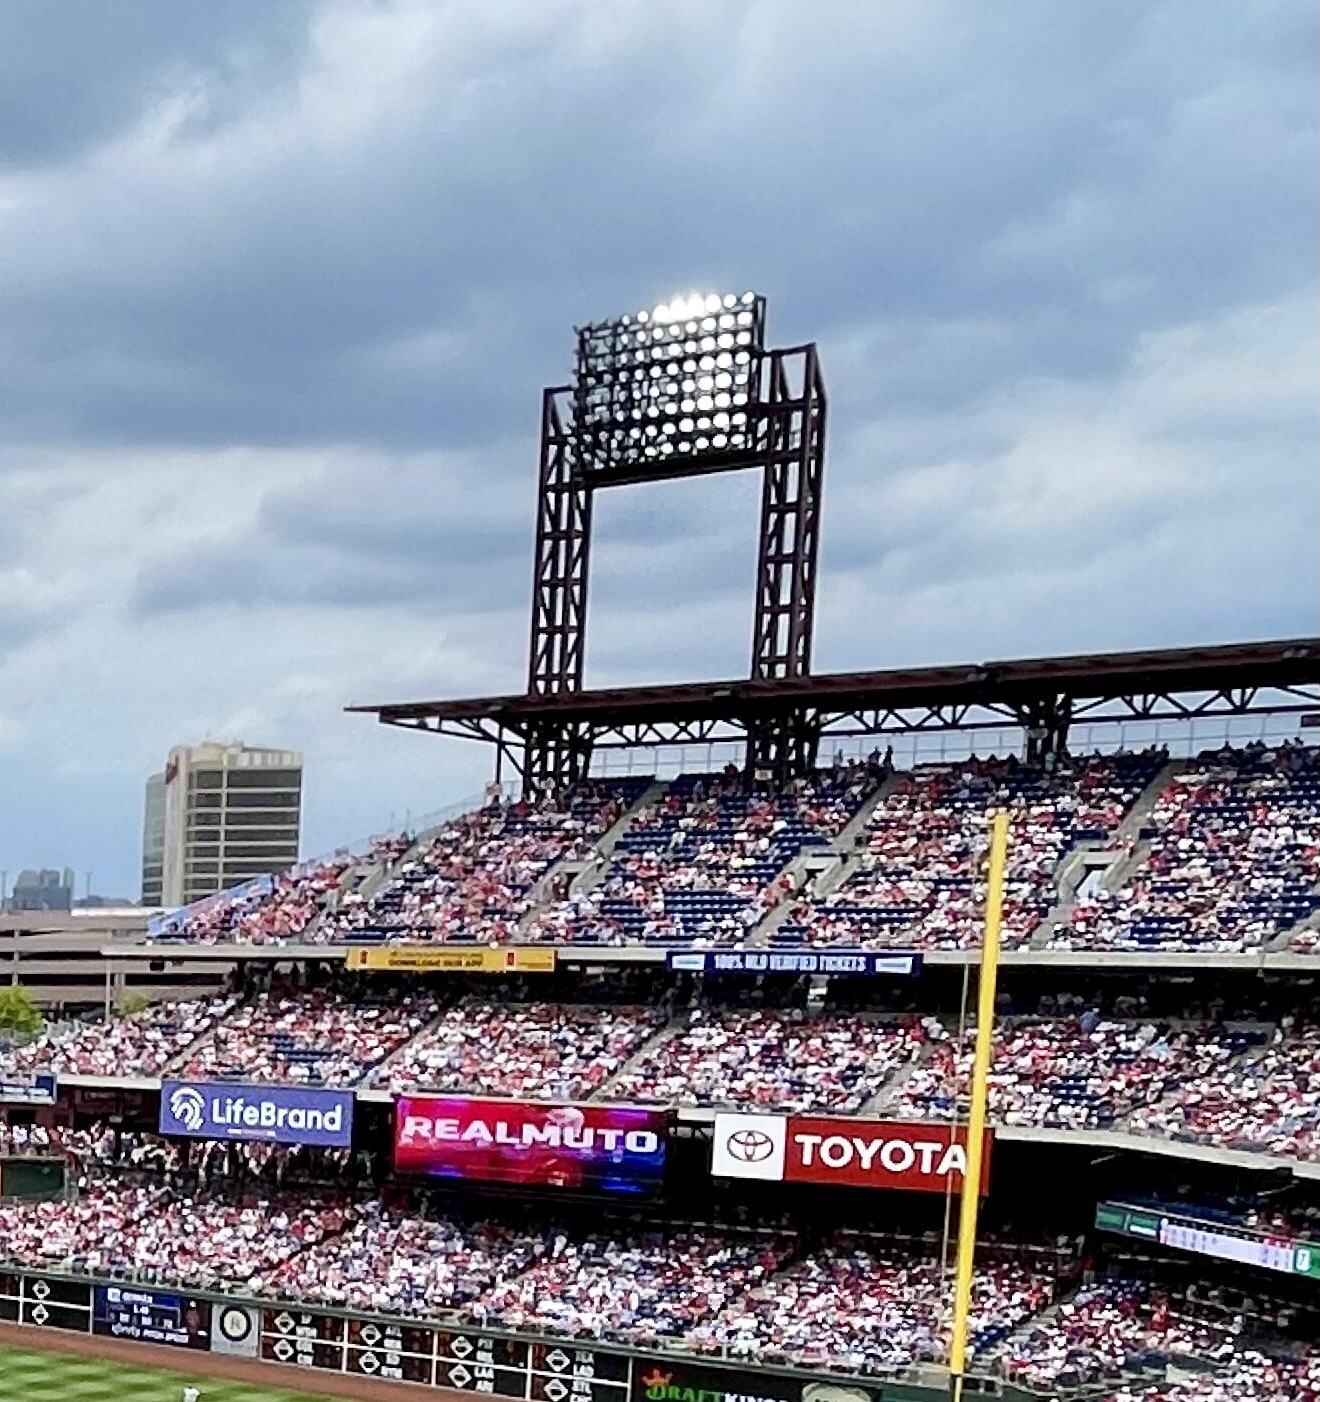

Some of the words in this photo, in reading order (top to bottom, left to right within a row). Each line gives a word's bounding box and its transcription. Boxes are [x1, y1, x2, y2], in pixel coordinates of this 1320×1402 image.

[211, 1098, 342, 1131] LifeBrand
[404, 1115, 658, 1153] REALMUTO
[794, 1135, 966, 1175] TOYOTA
